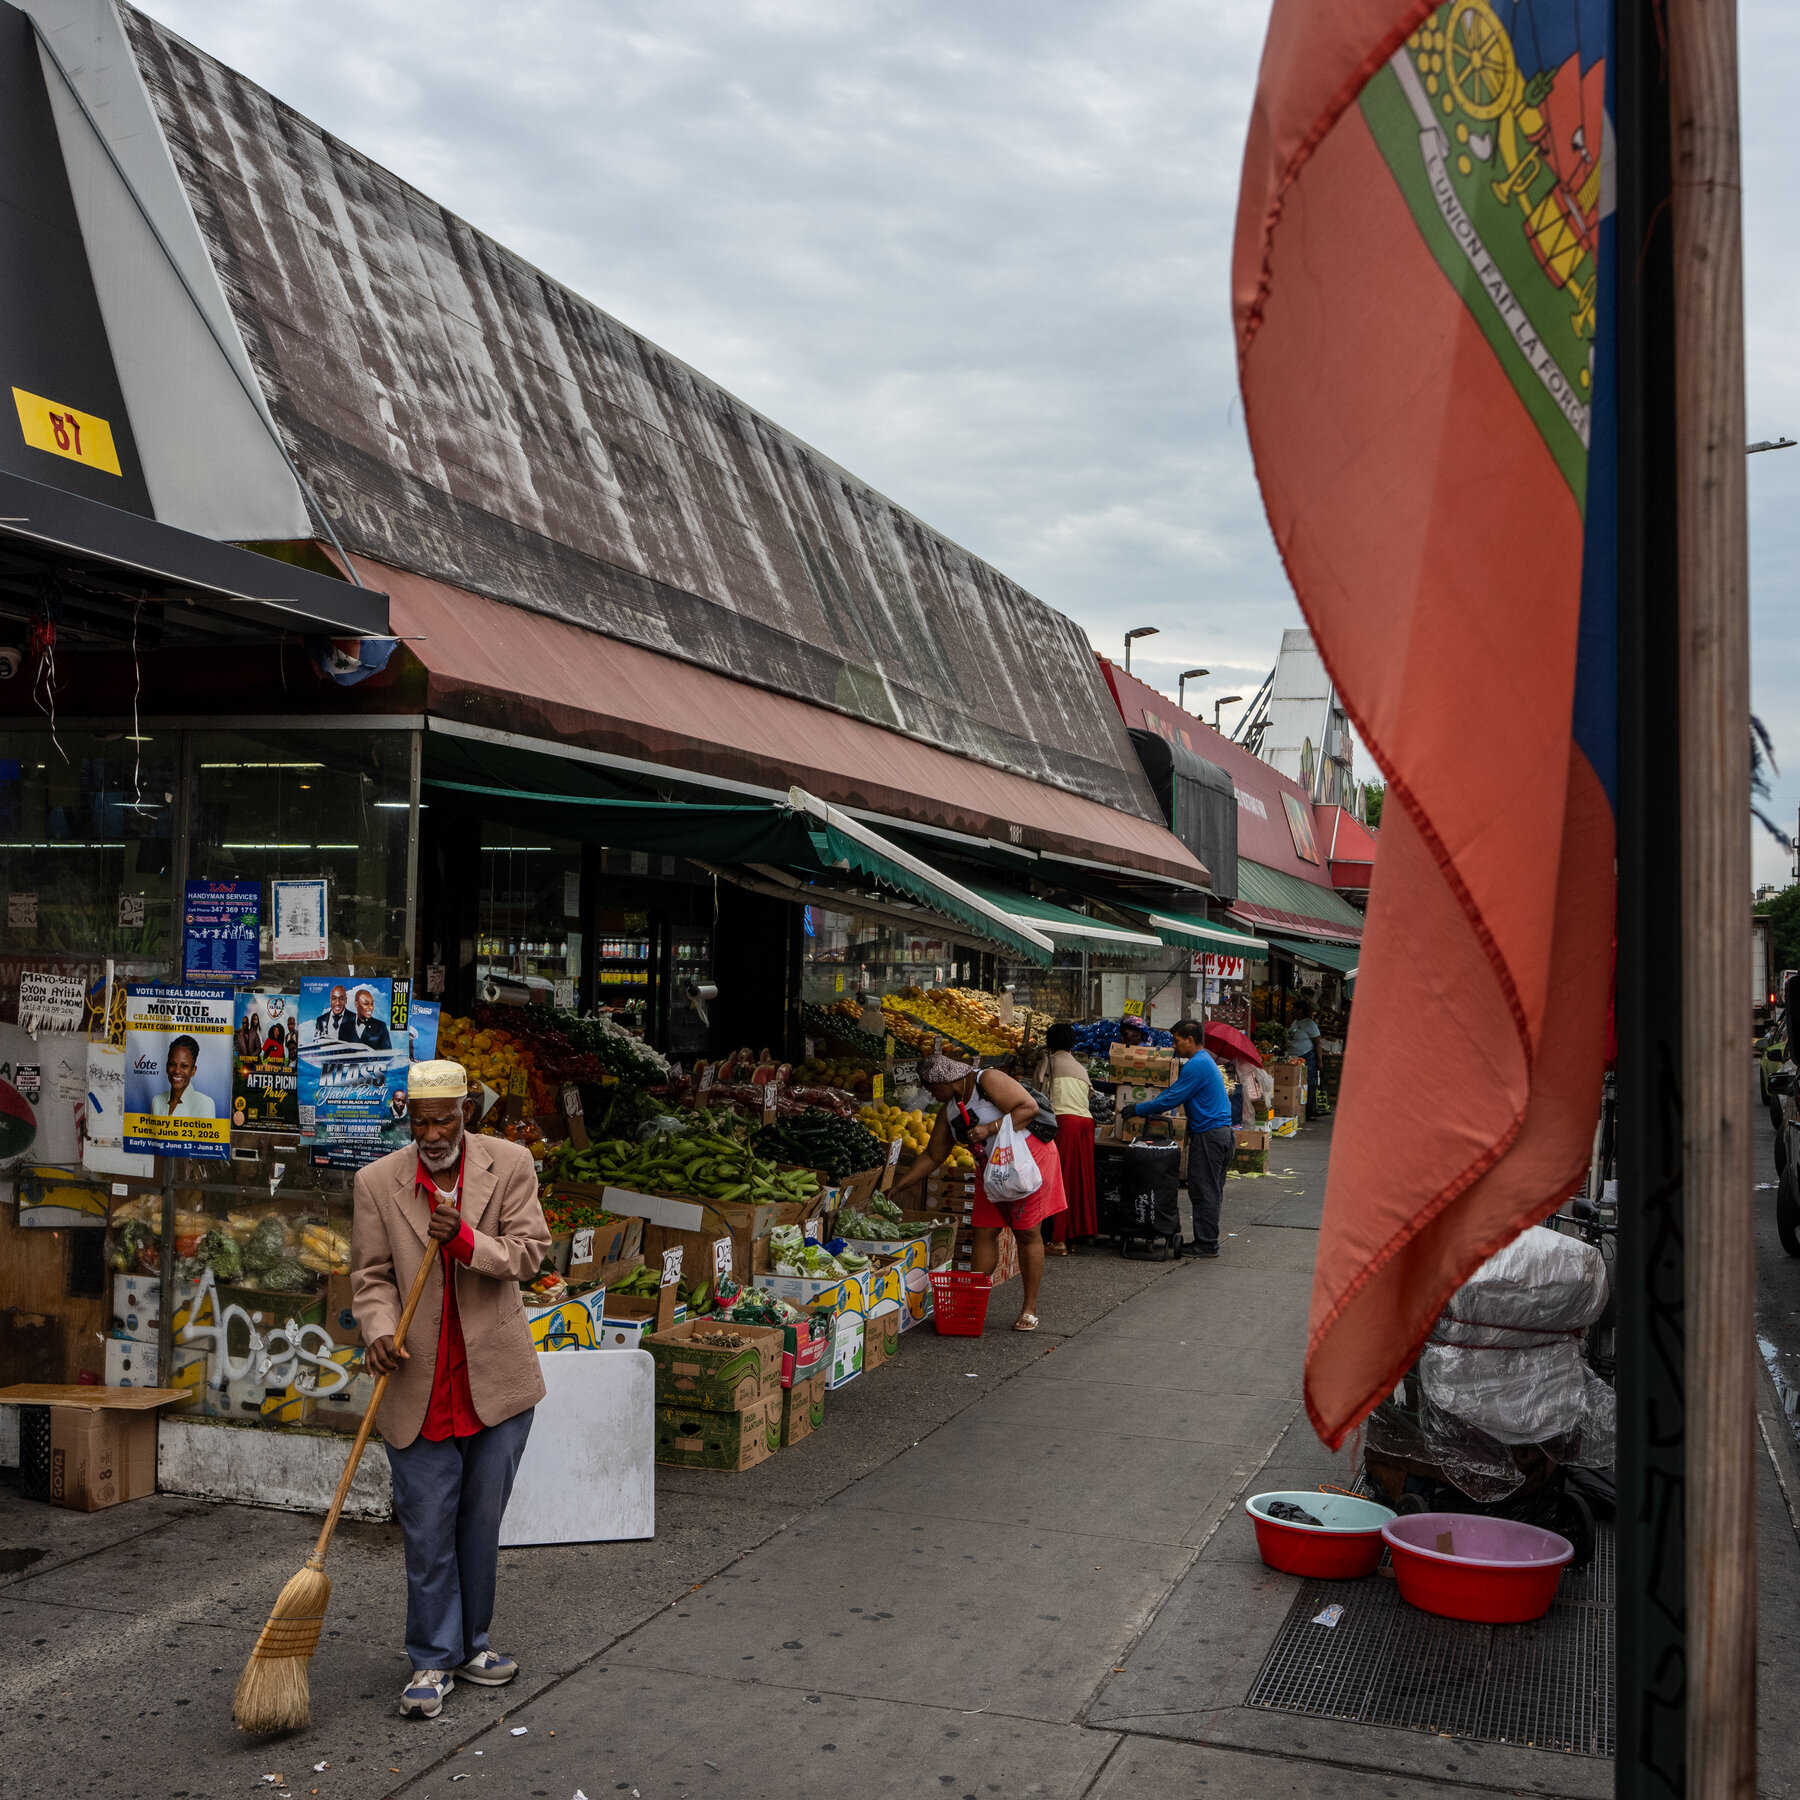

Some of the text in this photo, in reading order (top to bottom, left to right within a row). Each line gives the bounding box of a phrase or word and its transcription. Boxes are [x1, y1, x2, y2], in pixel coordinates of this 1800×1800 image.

[1430, 155, 1482, 258] L'UNION
[1482, 260, 1516, 317] FAIT
[1515, 321, 1537, 358] LA
[49, 411, 81, 455] 87
[226, 893, 258, 901] SERVICES
[21, 984, 46, 995] SYON
[166, 989, 183, 997] REAL
[185, 990, 225, 998] DEMOCRAT
[393, 982, 409, 993] SUN
[22, 994, 46, 1004] KOUP
[393, 993, 408, 1005] JUL
[147, 1005, 209, 1016] MONIQUE
[392, 1006, 407, 1024] 26
[155, 1023, 193, 1031] COMMITTEE
[195, 1025, 225, 1033] MEMBER
[319, 1062, 388, 1087] KLASS
[247, 1073, 274, 1089] AFTER
[262, 1086, 289, 1102] Party
[315, 1084, 388, 1107] Yacht Party
[140, 1117, 212, 1129] Primary Election
[158, 1128, 179, 1137] June
[182, 1129, 196, 1139] 23,
[198, 1130, 220, 1139] 2026
[129, 1139, 147, 1148] Early
[147, 1140, 164, 1149] Voting
[165, 1141, 182, 1149] June
[53, 1454, 64, 1499] GOYA
